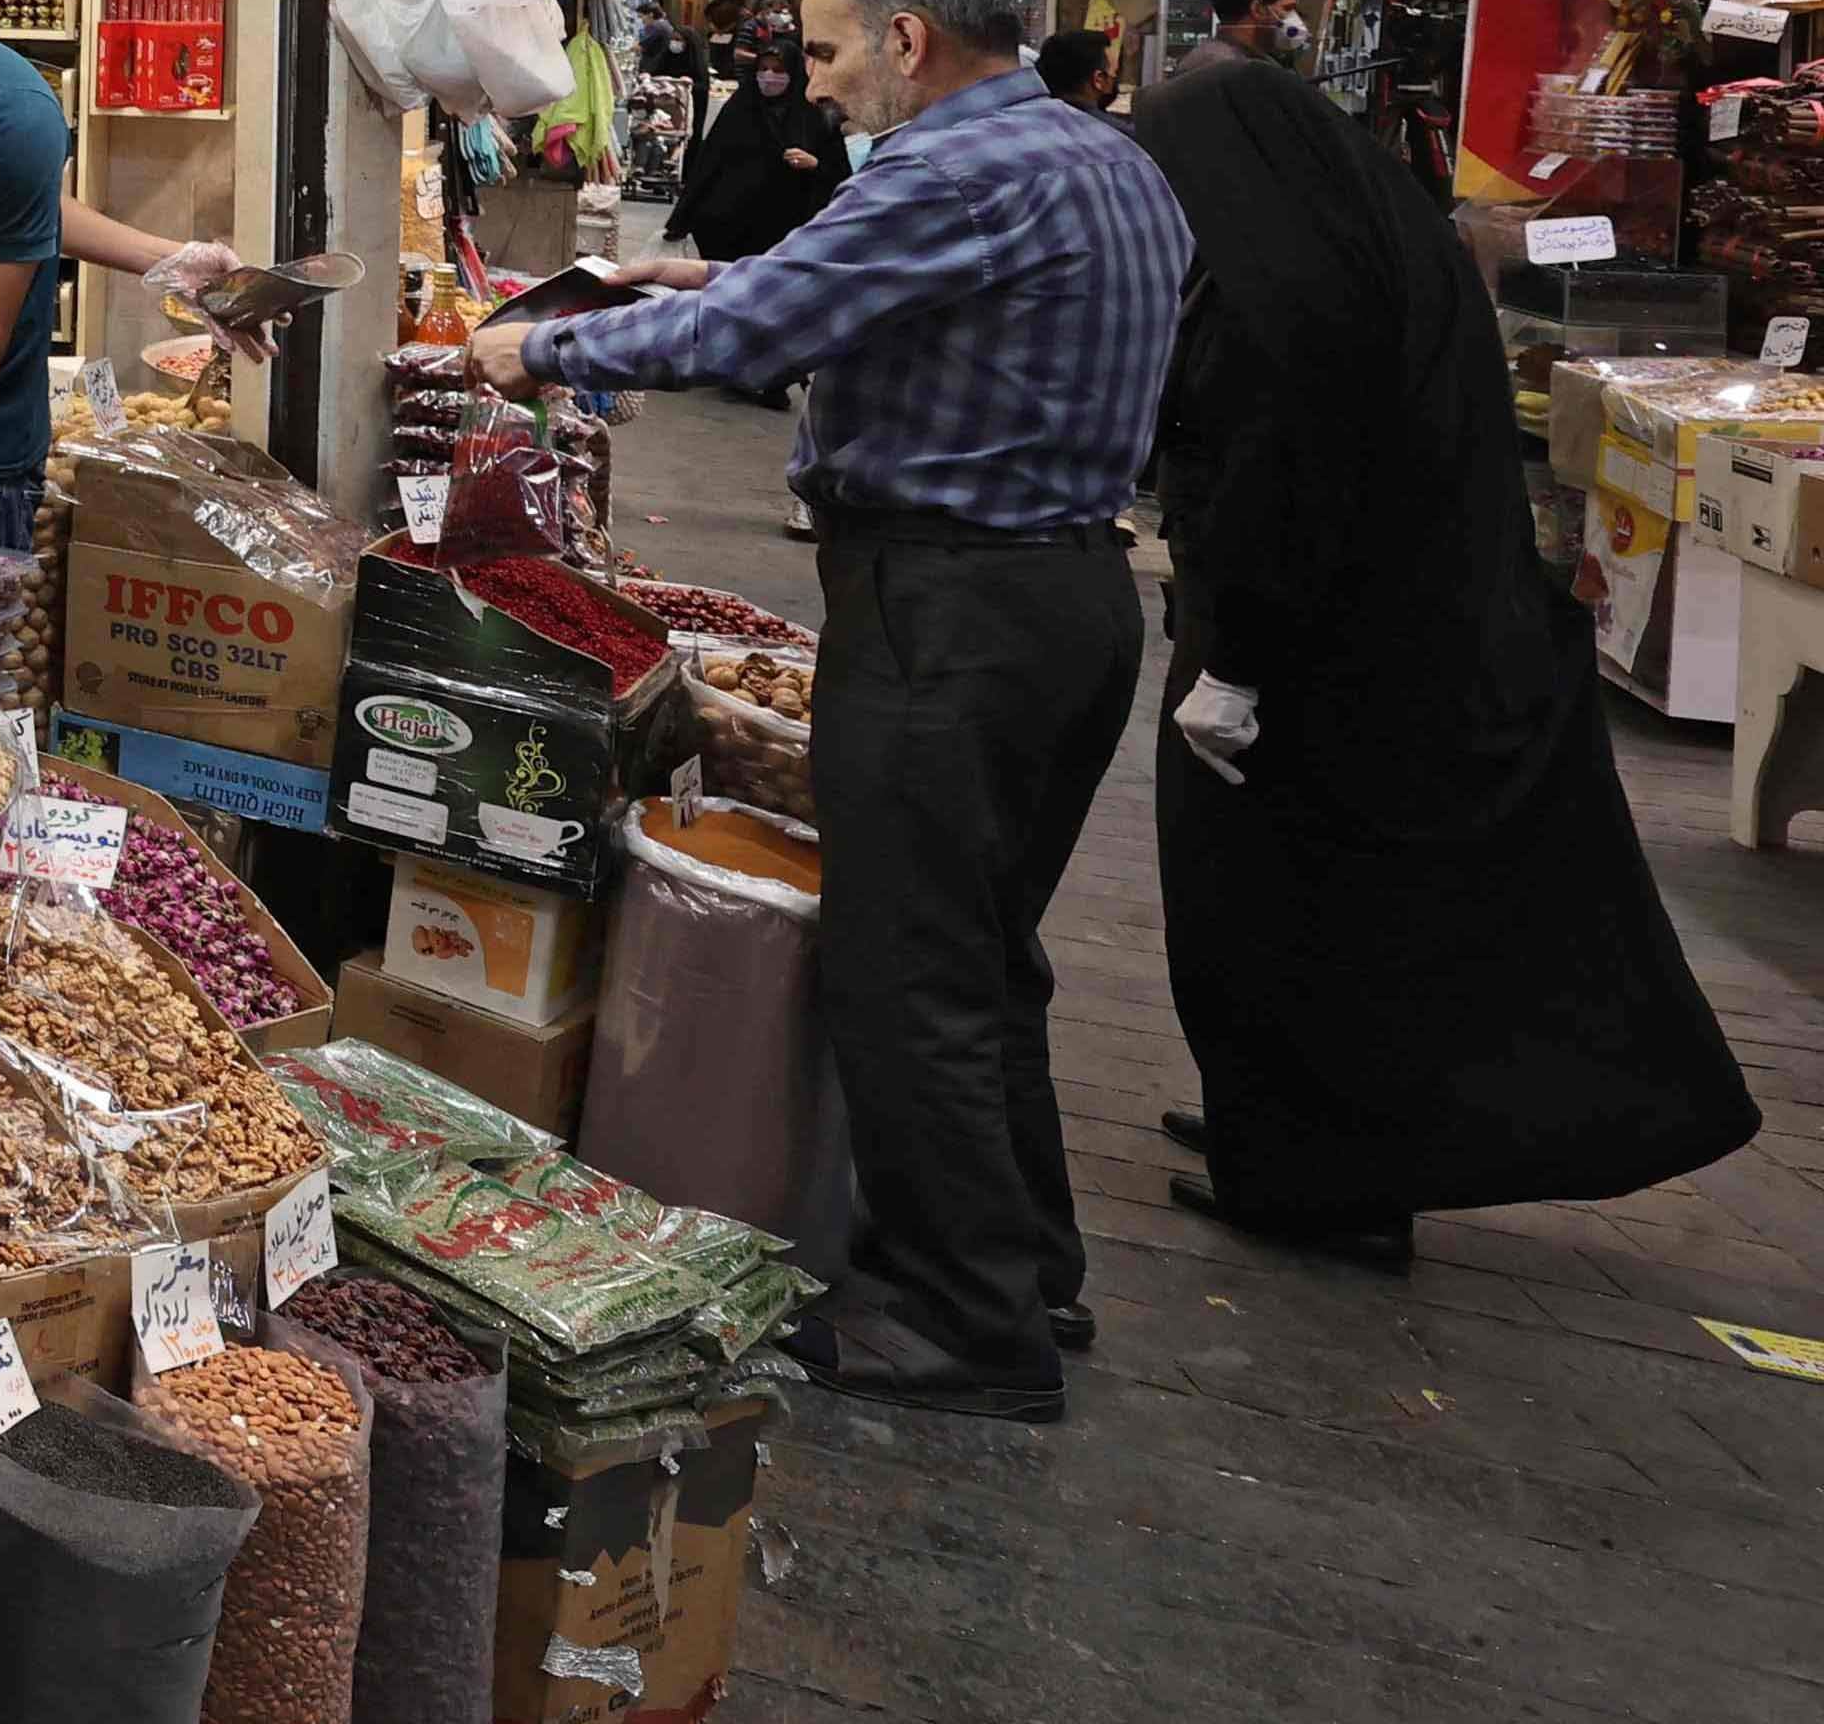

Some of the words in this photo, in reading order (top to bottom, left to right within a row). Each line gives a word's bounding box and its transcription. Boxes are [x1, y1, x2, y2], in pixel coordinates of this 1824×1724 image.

[103, 573, 295, 645] IFFCO
[111, 621, 158, 648] PRO
[168, 632, 218, 661] SCO
[226, 644, 289, 673] 32LT
[170, 656, 221, 683] CBS
[377, 706, 440, 743] Hajat
[193, 782, 259, 812] QUALITY
[262, 799, 305, 824] HIGH
